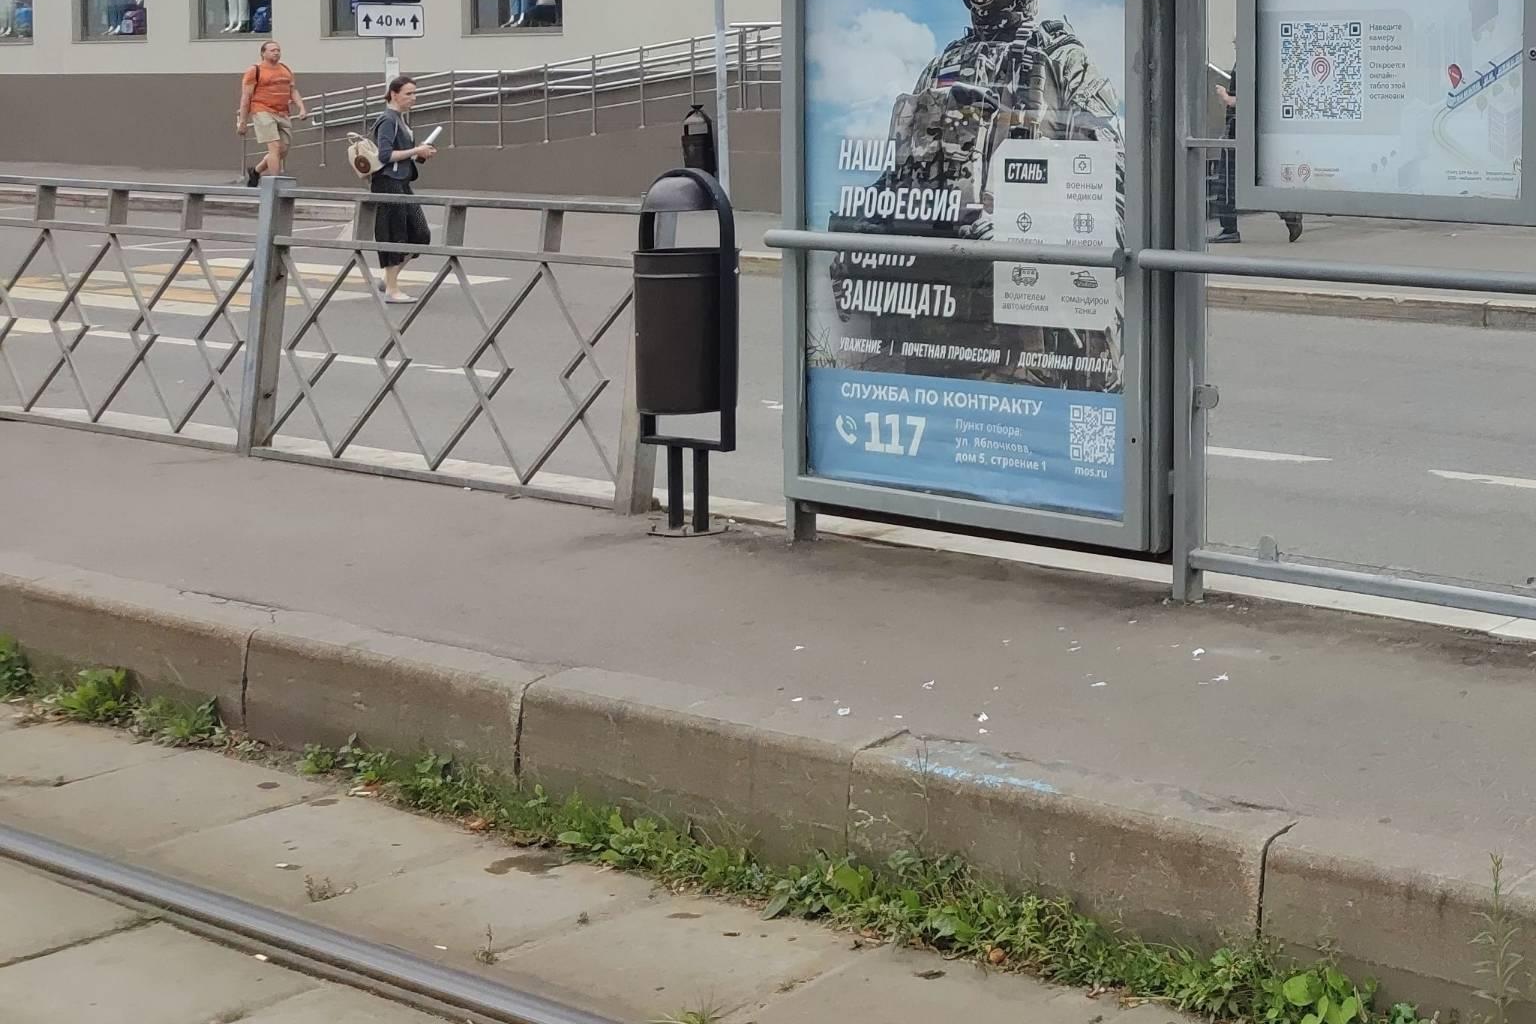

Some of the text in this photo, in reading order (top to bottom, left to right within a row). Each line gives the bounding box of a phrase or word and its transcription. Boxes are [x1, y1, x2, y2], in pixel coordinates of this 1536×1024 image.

[376, 15, 392, 26] 40
[838, 138, 897, 172] НАША
[838, 185, 962, 222] ПРОФЕССИЯ
[840, 278, 957, 318] ЗАЩИЩАТЬ
[839, 336, 1114, 374] УВАЖЕНИЕ ПОЧЕТНАЯ ПРОФЕССИЯ ДОСТОЙНАЯ ОПЛАТА
[841, 382, 1043, 416] СЛУЖБА ПО КОНТРАКТУ
[864, 411, 928, 457] 117
[955, 417, 984, 433] Пункт
[955, 452, 977, 464] дом
[990, 454, 1040, 470] строение
[1041, 460, 1047, 472] 1
[1074, 466, 1108, 479] mos.ru
